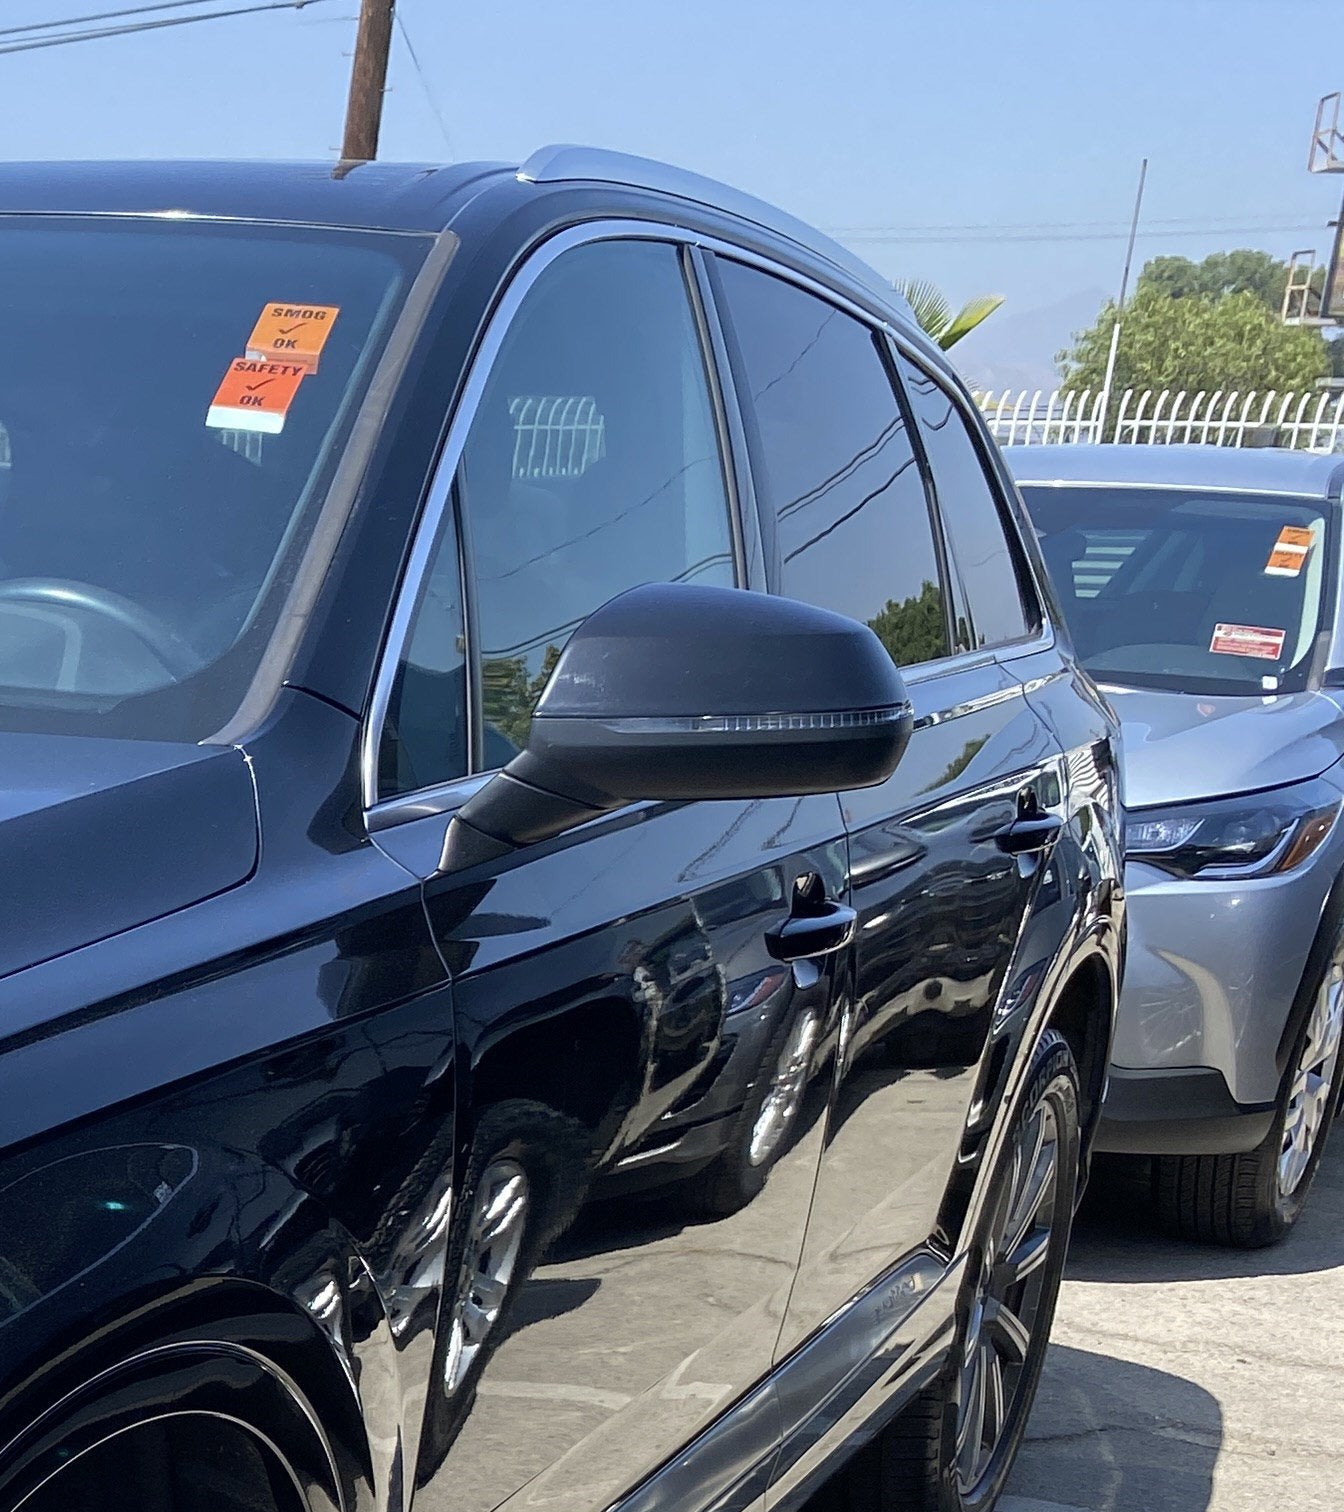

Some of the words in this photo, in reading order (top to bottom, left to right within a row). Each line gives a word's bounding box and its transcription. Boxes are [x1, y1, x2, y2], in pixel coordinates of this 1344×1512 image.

[271, 307, 328, 321] SMOG
[272, 337, 299, 350] OK
[233, 360, 303, 377] SAFETY
[239, 395, 267, 407] OK
